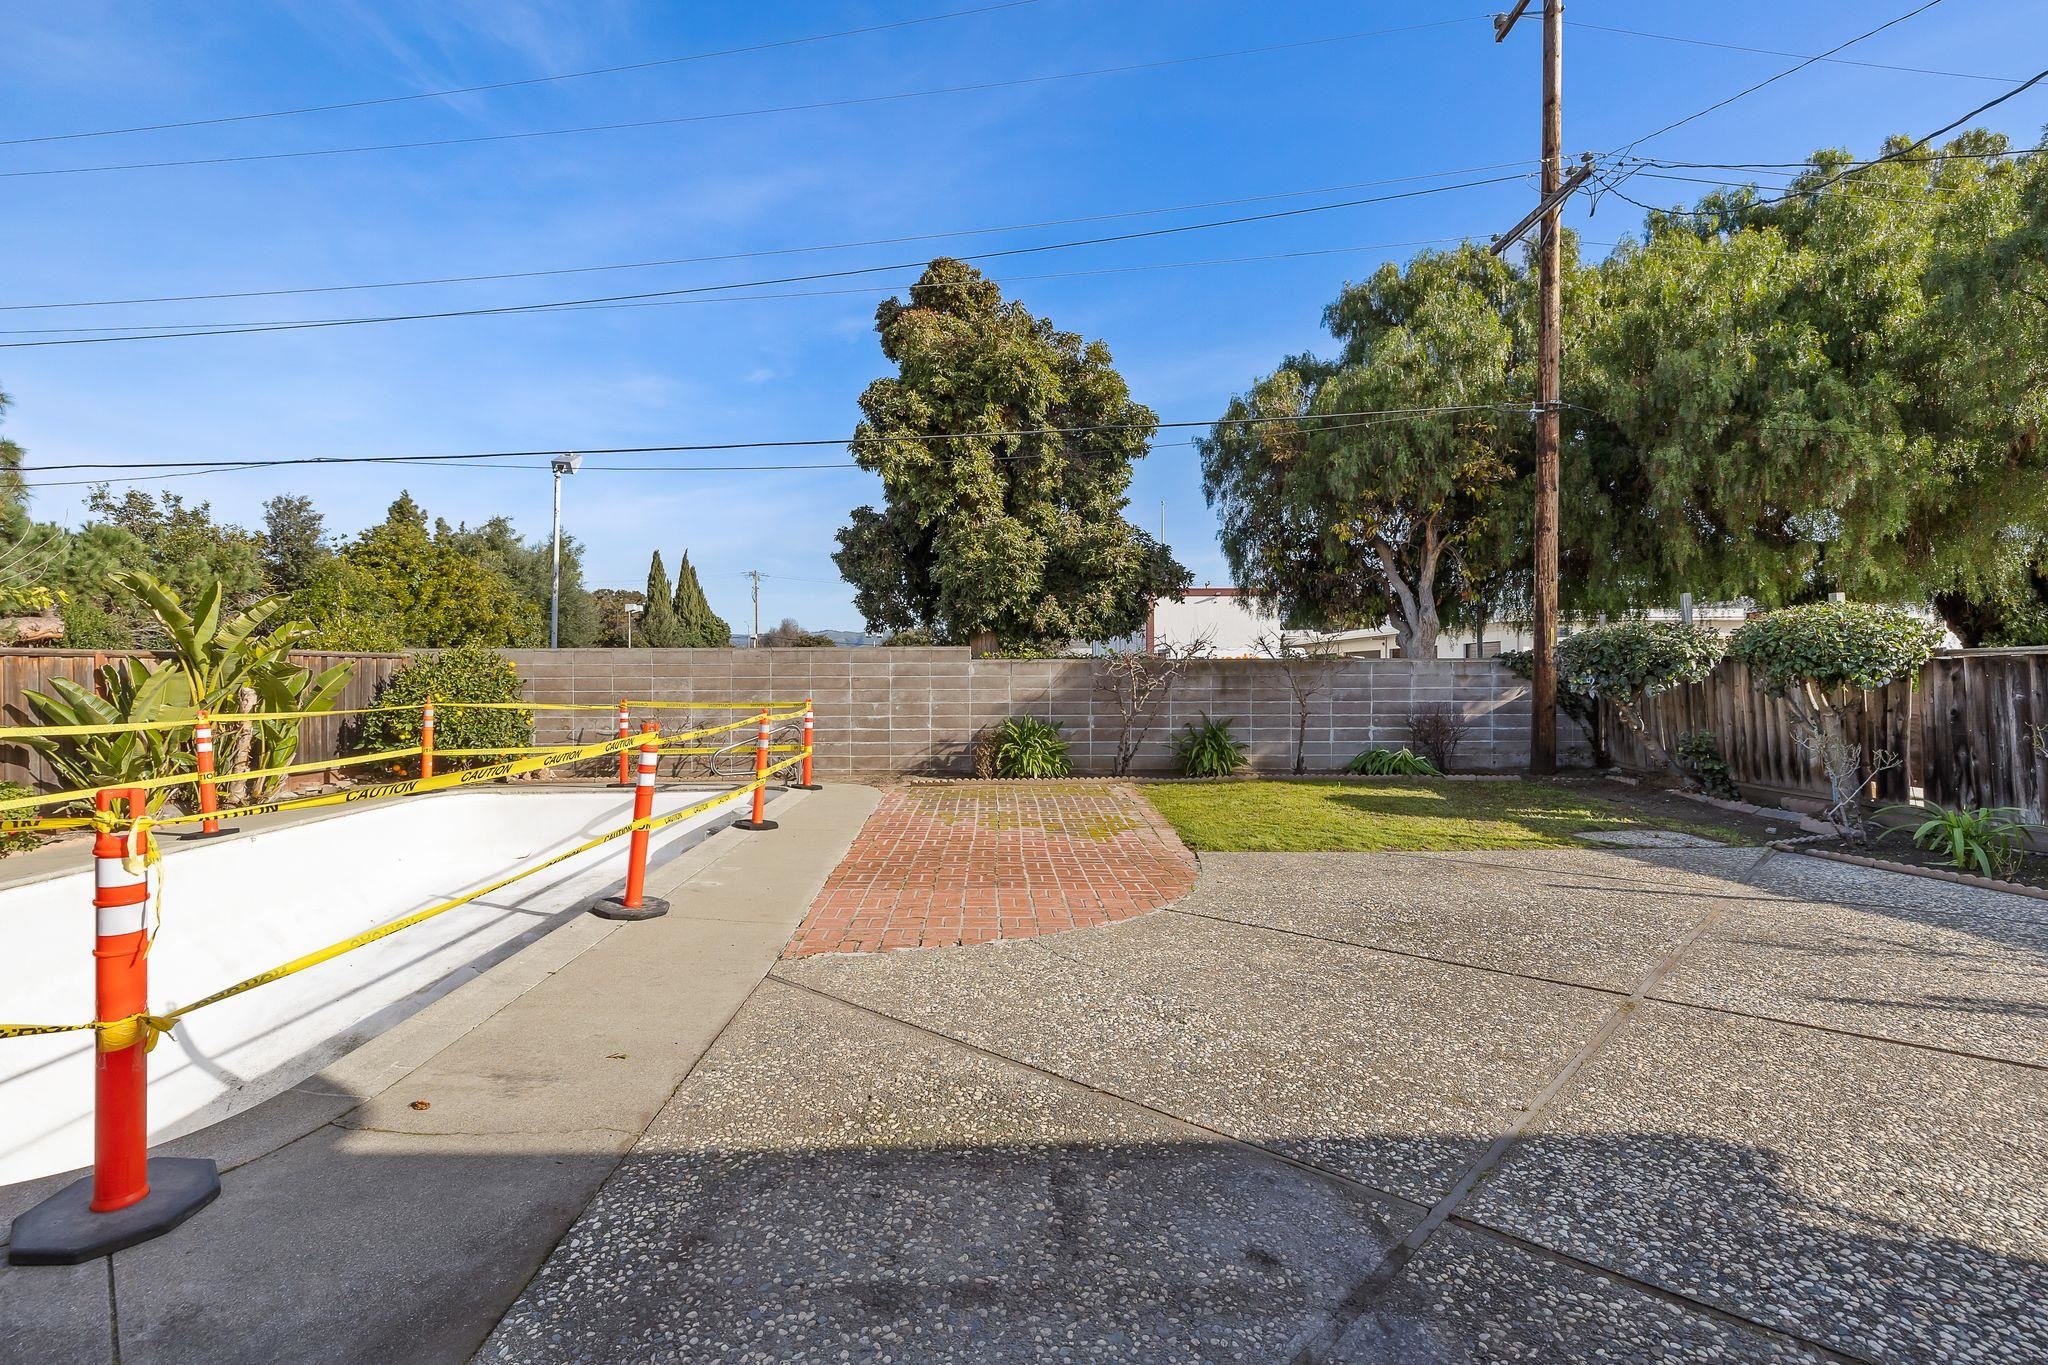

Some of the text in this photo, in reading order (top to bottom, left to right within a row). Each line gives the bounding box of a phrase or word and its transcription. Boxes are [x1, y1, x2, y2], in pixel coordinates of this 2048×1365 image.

[346, 737, 635, 802] CAUTION CAUTION CAUTION CAUTION
[603, 824, 633, 842] CAUTION
